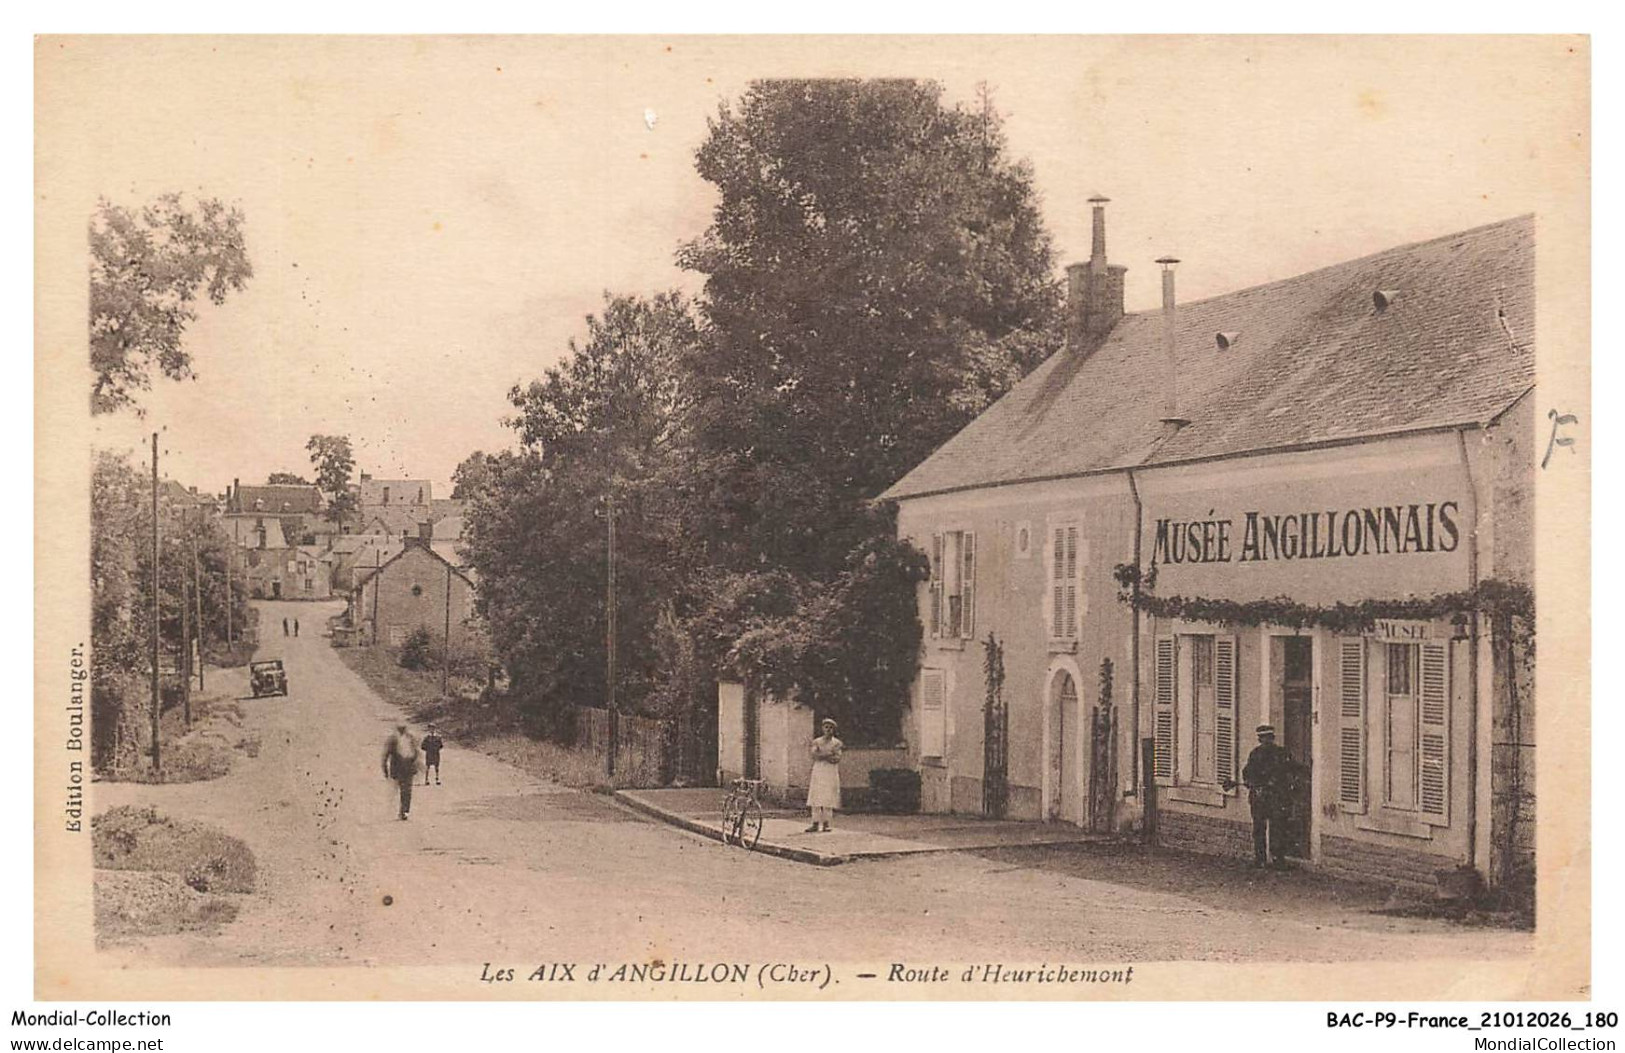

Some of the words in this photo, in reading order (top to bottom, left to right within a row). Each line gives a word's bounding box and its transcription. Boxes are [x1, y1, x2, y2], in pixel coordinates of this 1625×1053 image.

[1153, 509, 1232, 564] MUSÉE
[1239, 501, 1460, 562] ANGILLONNAIS
[67, 643, 86, 750] Boulanger.
[66, 762, 83, 832] Edition
[480, 962, 515, 984] Les
[529, 963, 576, 983] AIX
[588, 960, 750, 983] d'ANGILLON
[759, 963, 840, 990] (Cher).
[889, 963, 949, 983] Route
